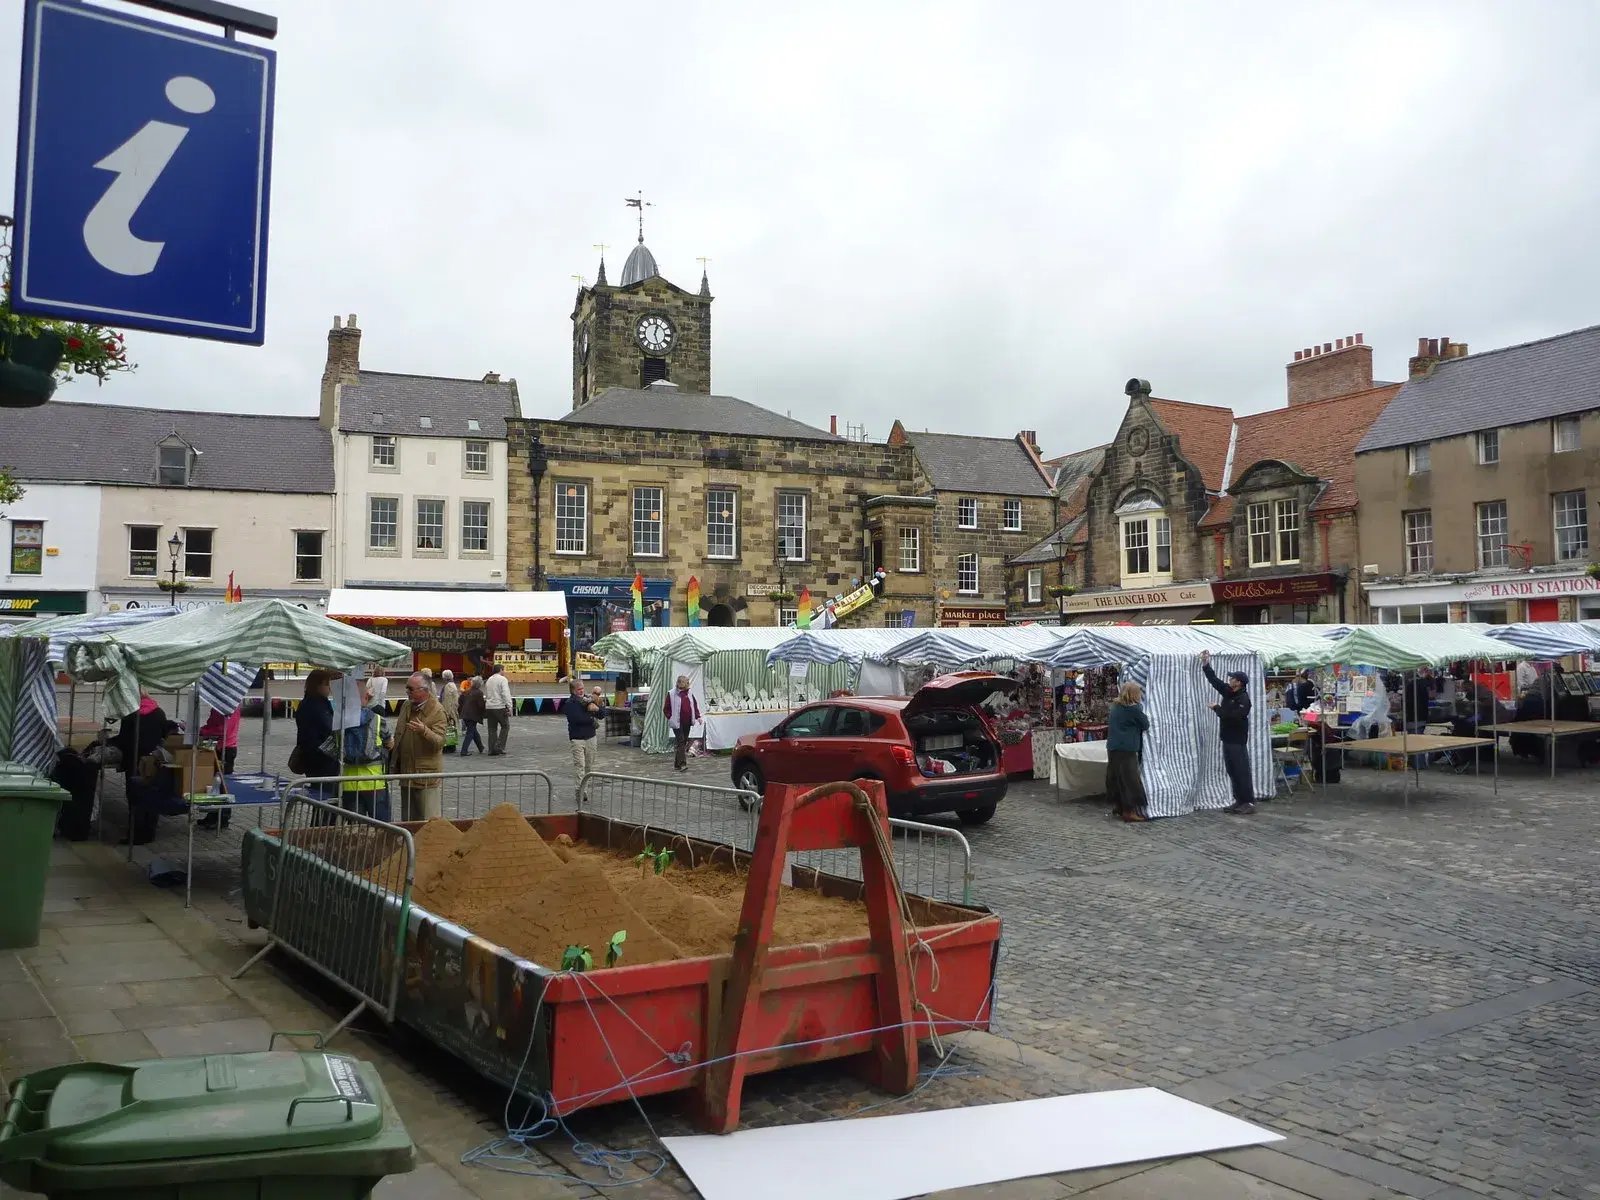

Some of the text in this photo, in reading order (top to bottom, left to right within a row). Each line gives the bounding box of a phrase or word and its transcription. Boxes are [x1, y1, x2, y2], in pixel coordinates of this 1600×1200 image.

[571, 585, 609, 595] CHISHOLM
[1490, 582, 1534, 597] HANDI
[1537, 576, 1600, 594] STATIONE
[0, 598, 39, 610] UBWAY
[1093, 596, 1113, 607] THE
[1114, 594, 1145, 606] LUNCH
[1147, 592, 1168, 603] BOX
[1180, 591, 1196, 600] Cafe
[387, 627, 408, 638] and
[410, 627, 434, 639] visit
[435, 630, 456, 640] our
[456, 629, 487, 640] brand
[431, 639, 469, 653] Display
